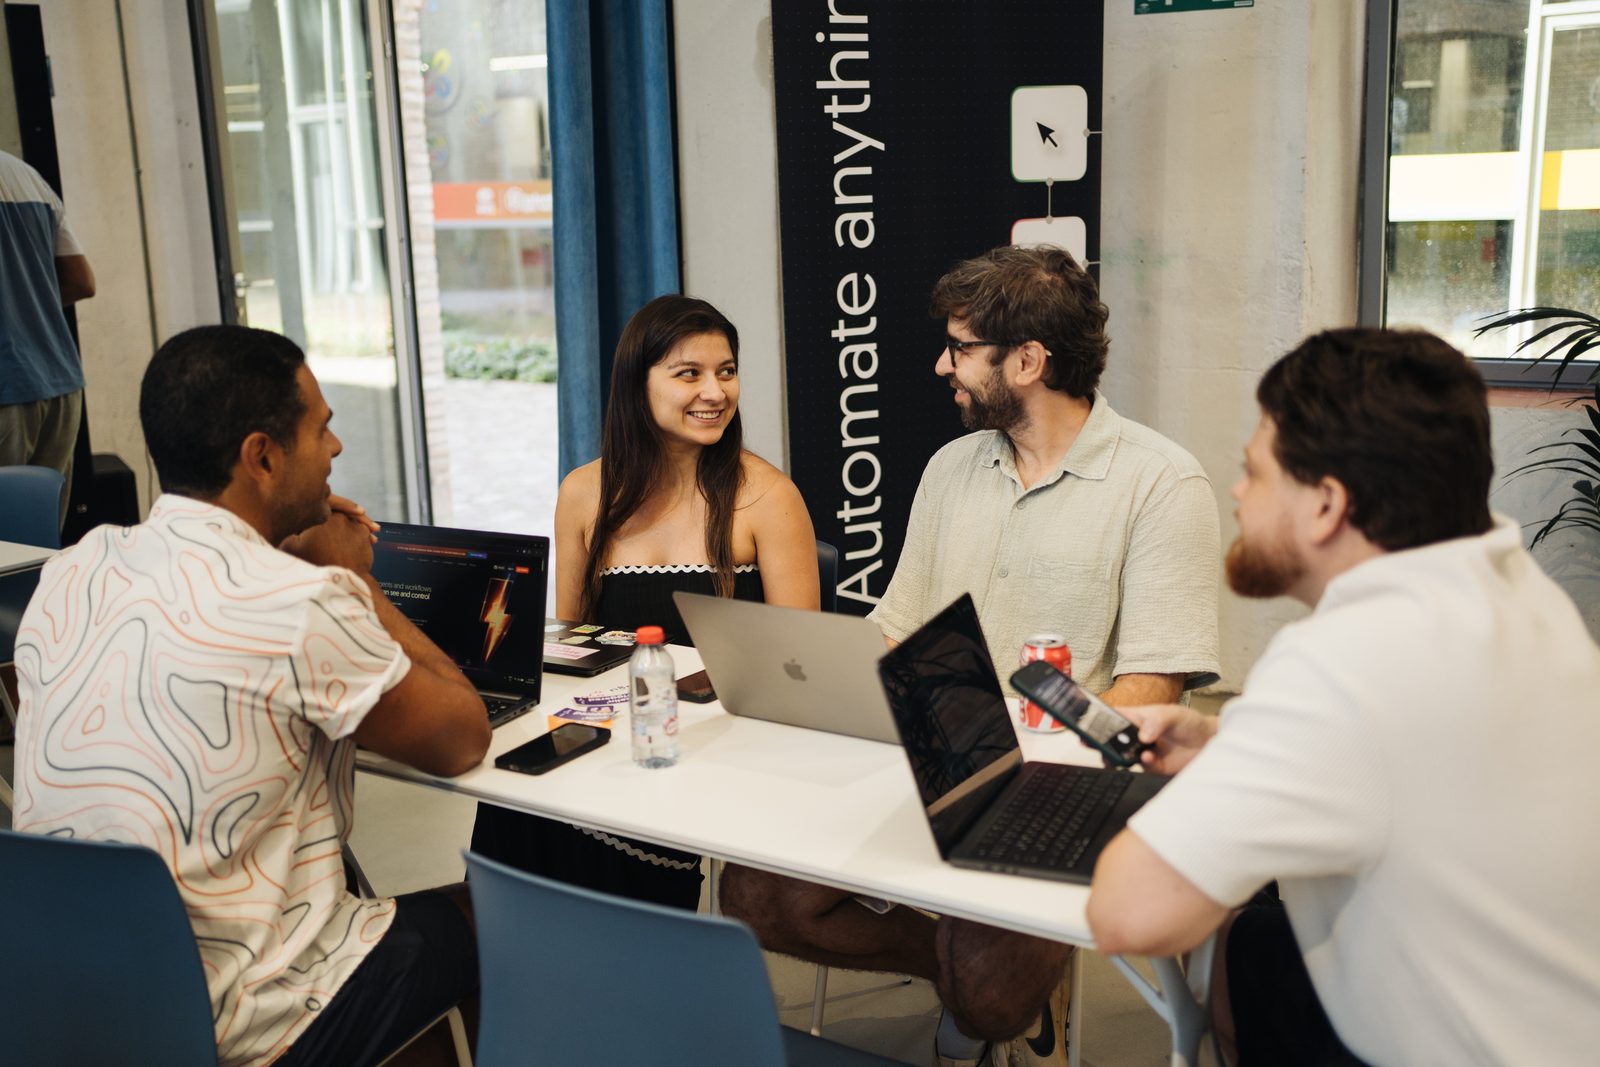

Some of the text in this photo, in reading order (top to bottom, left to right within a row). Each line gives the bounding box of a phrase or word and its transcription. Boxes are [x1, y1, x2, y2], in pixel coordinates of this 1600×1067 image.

[831, 272, 883, 606] Automate
[405, 584, 432, 592] workflows
[411, 592, 430, 600] control
